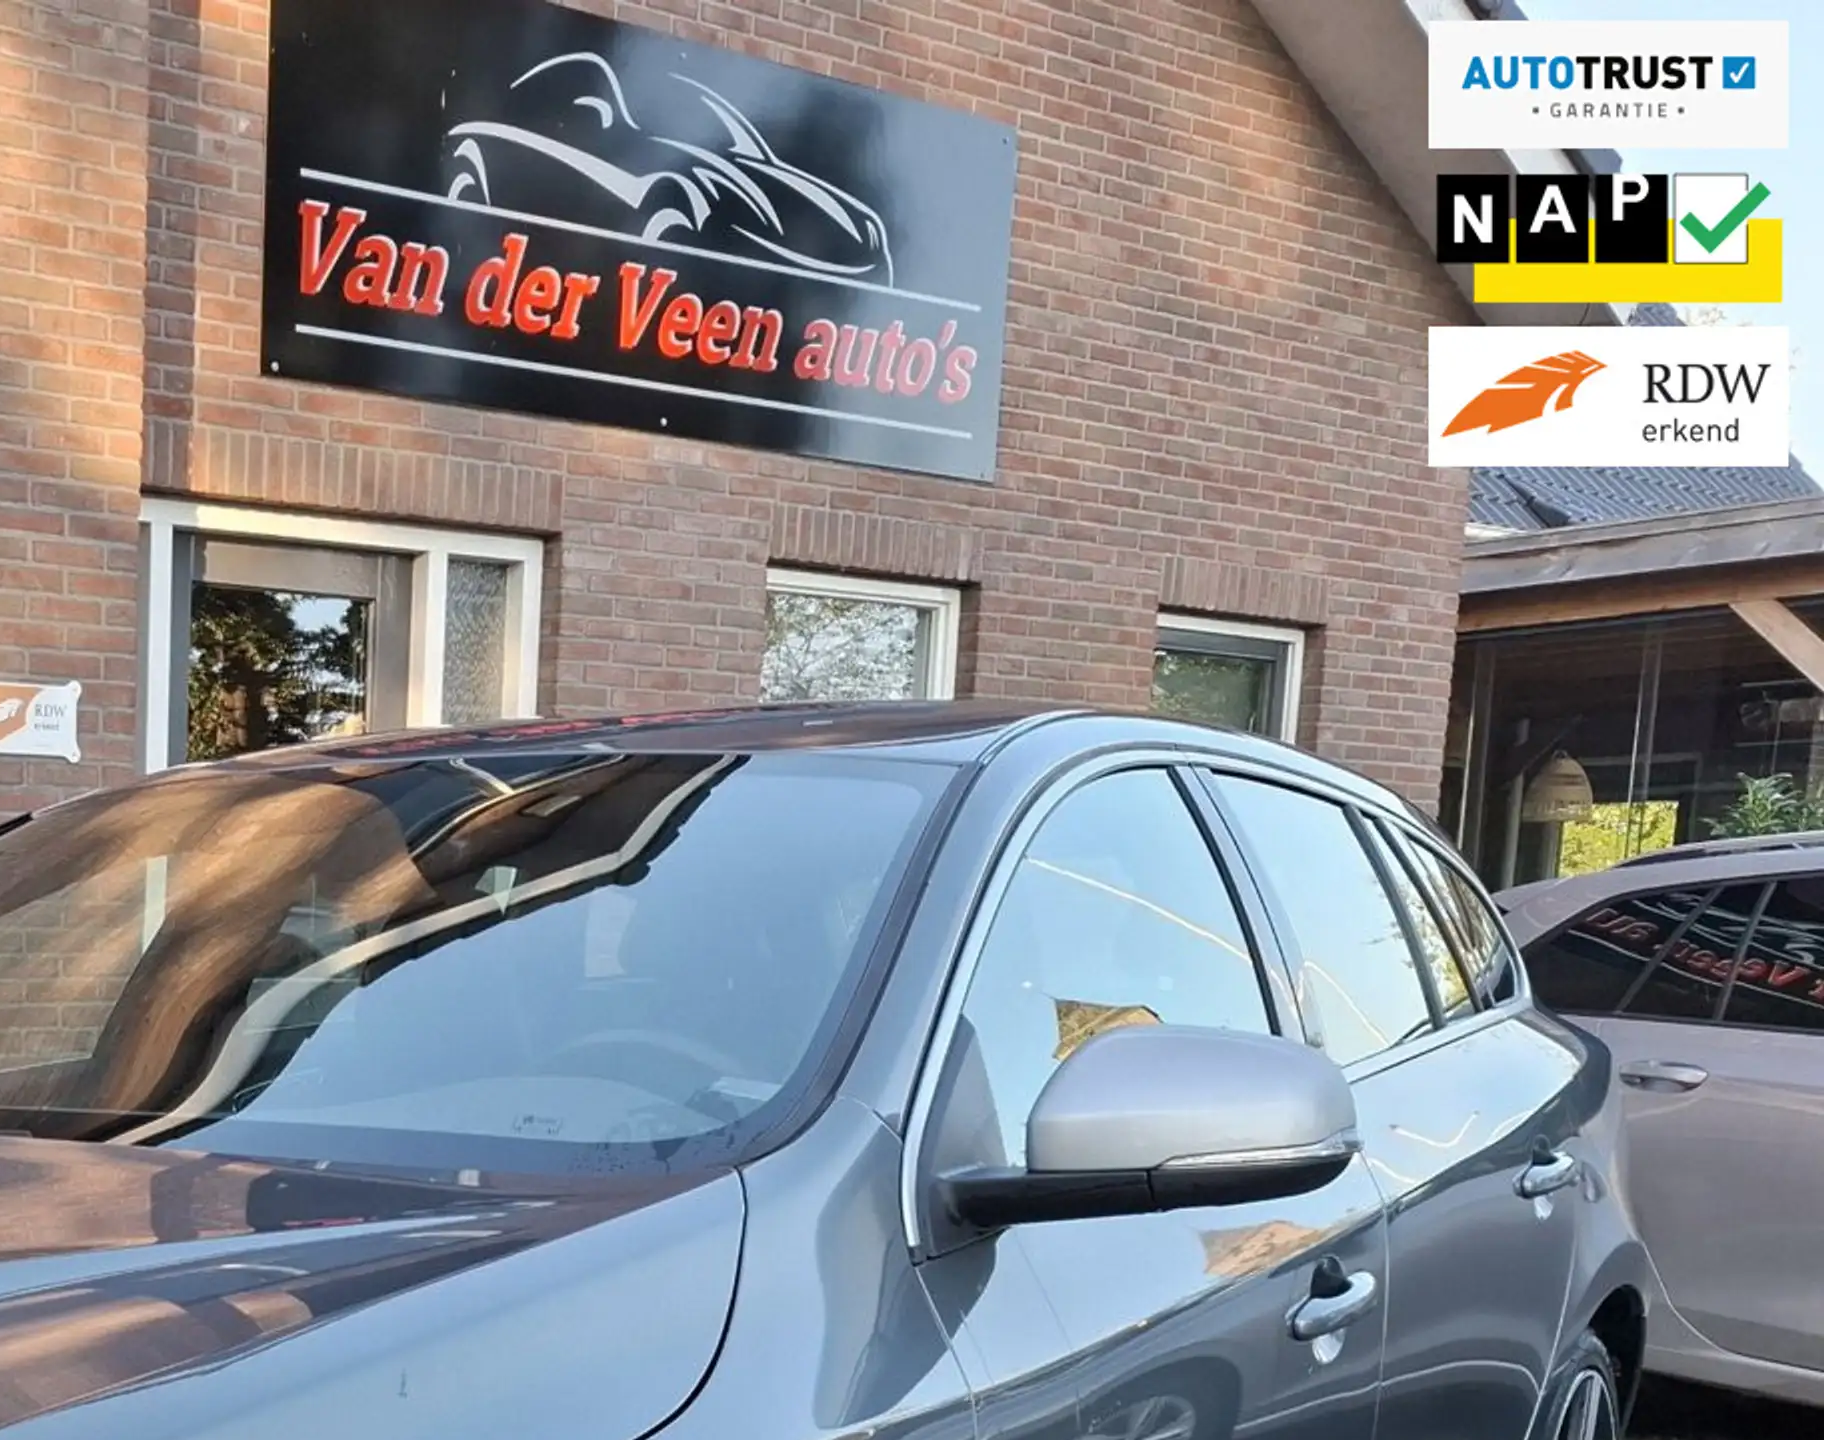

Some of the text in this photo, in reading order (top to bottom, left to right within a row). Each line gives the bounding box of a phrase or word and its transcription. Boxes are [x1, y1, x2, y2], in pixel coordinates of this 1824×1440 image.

[296, 200, 978, 404] Van der Veen auto's
[35, 703, 66, 717] RDW
